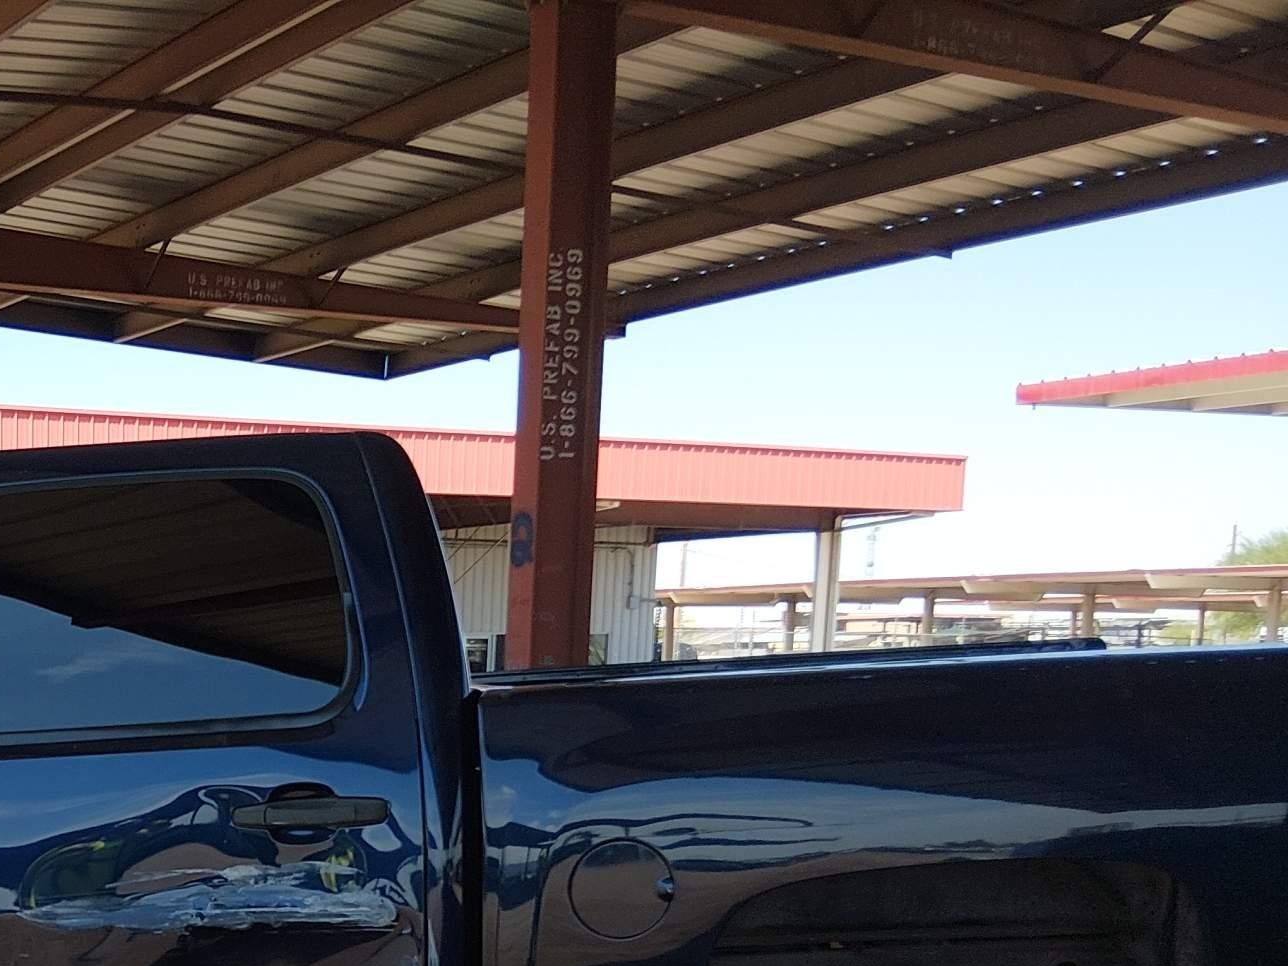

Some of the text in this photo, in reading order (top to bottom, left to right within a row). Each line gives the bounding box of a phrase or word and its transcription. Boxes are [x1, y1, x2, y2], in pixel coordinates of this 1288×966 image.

[543, 305, 562, 400] PREFAB
[558, 248, 583, 458] 1-866-799-0969
[539, 415, 558, 461] U.S.
